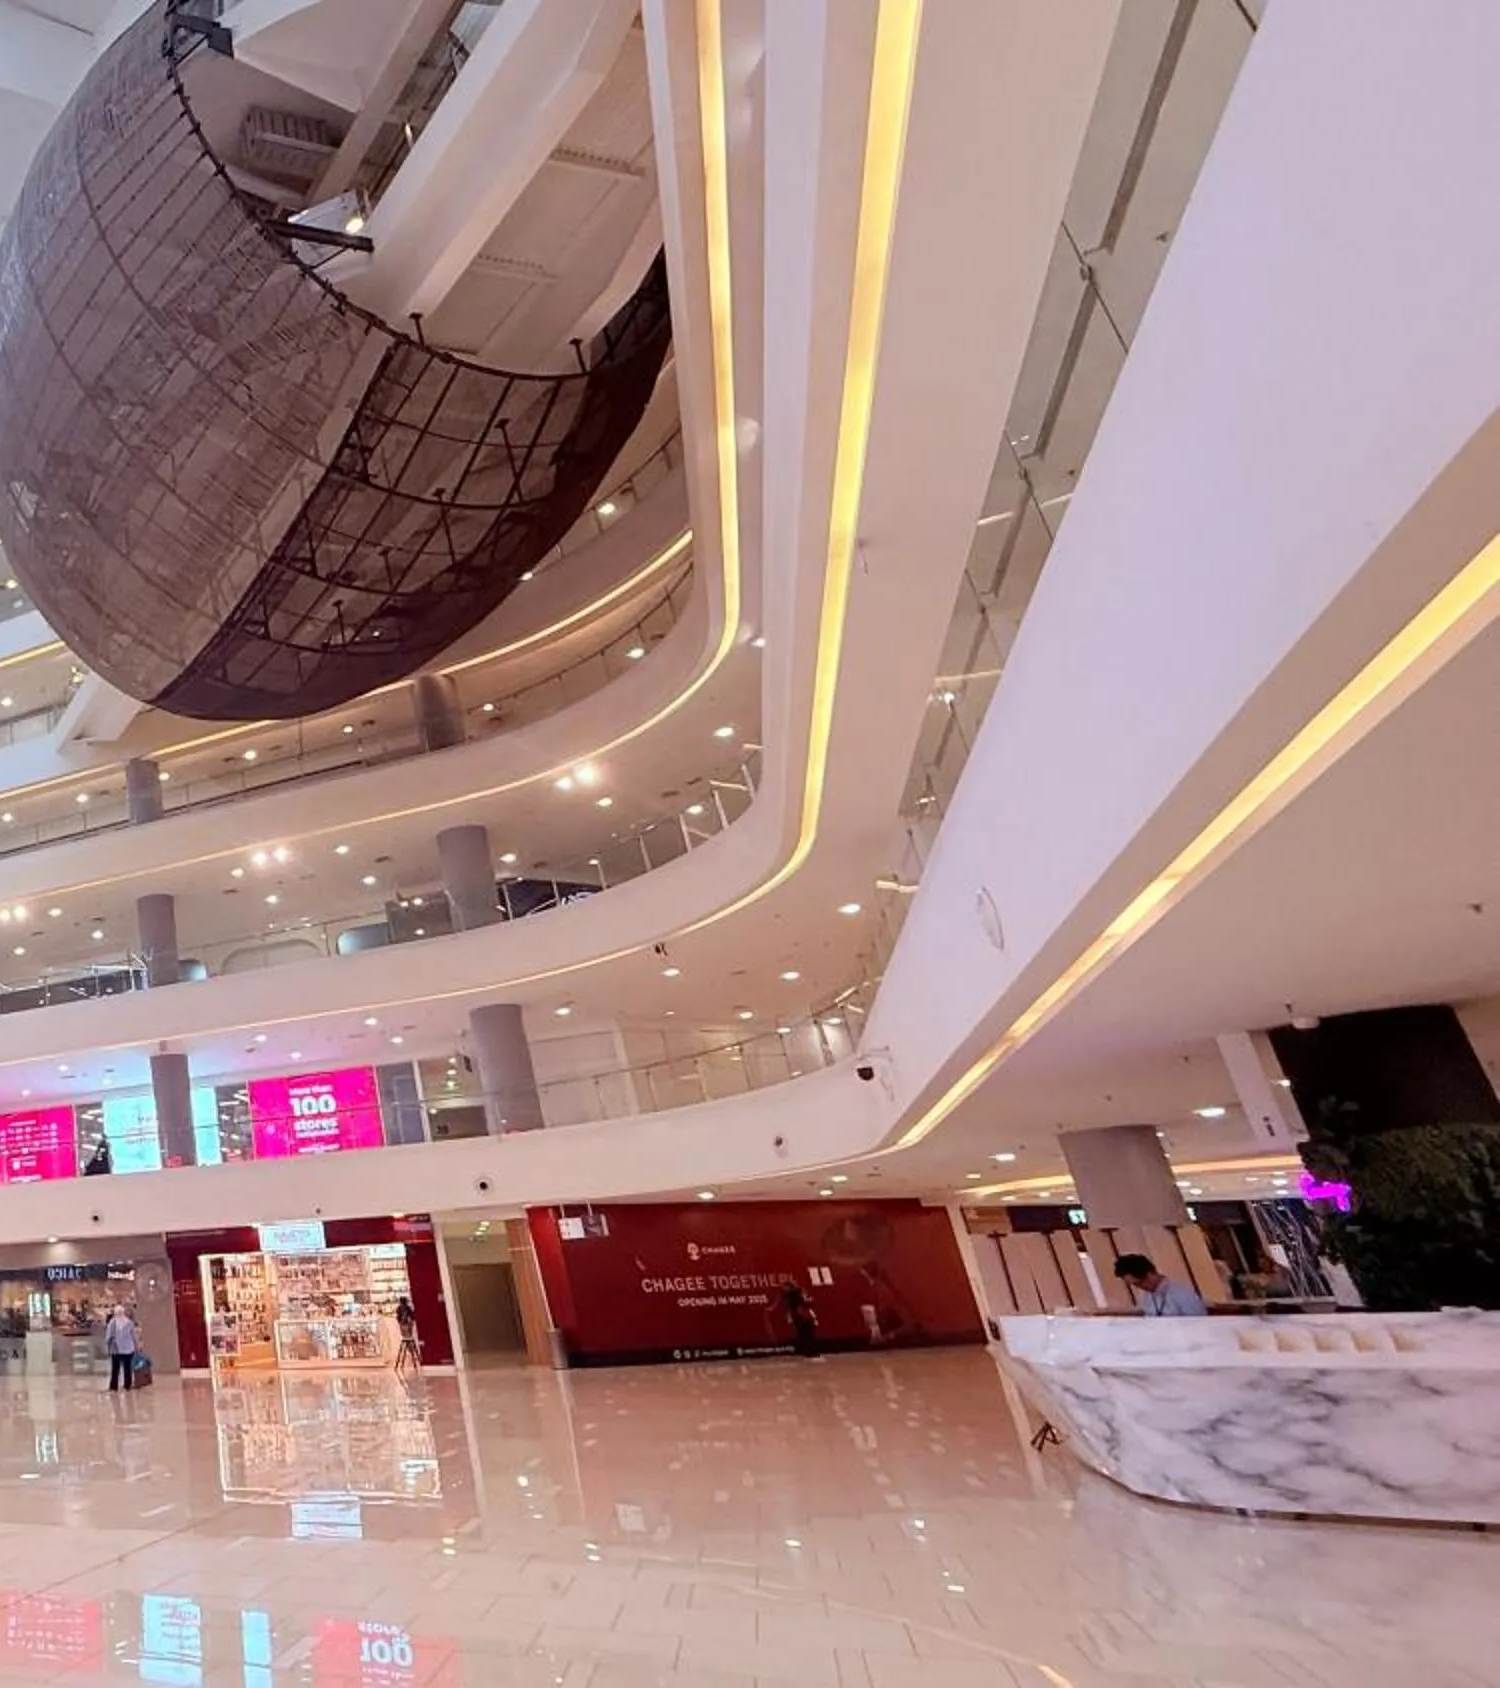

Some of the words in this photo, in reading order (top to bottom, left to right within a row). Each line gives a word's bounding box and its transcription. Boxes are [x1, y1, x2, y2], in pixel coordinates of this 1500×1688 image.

[289, 1094, 336, 1116] 100
[641, 1276, 707, 1293] CHAGEE
[677, 1296, 716, 1308] OPENING
